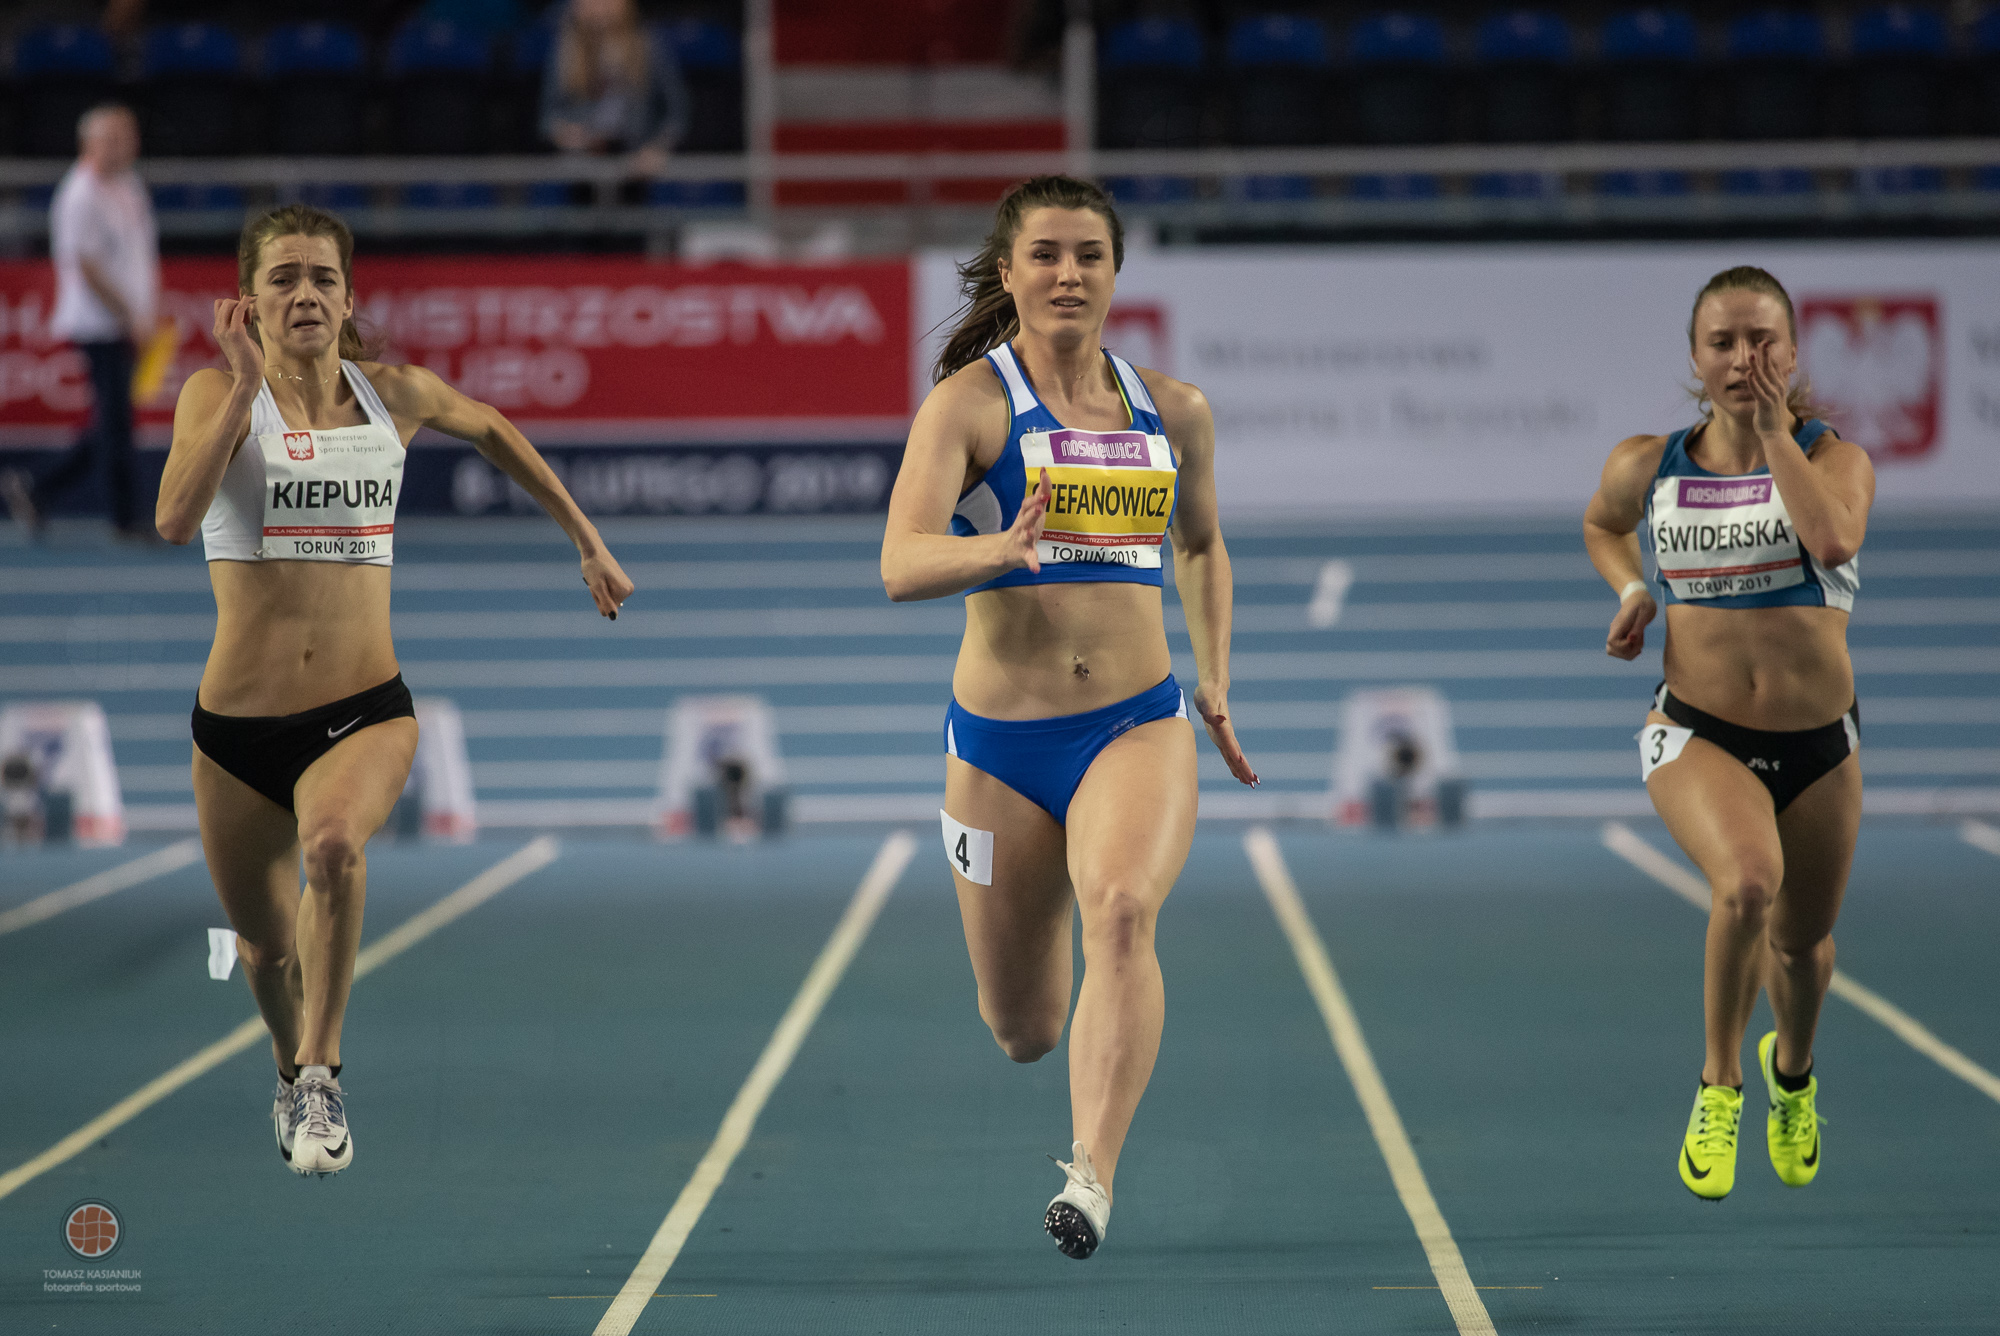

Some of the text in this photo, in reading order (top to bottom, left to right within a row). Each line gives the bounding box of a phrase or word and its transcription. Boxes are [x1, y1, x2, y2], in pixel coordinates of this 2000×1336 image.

[316, 434, 368, 442] Ministerstwo
[318, 446, 345, 455] Sportu
[352, 444, 385, 455] Turystyki
[272, 479, 393, 509] KIEPURA
[1032, 482, 1168, 518] TEFANOWICZ
[1045, 533, 1074, 541] HALOWE
[1075, 536, 1119, 544] MISTRZOSTWA
[1657, 518, 1790, 554] ŚWIDERSKA
[294, 537, 376, 554] TORUŃ 2019
[1052, 546, 1138, 564] TORUŃ 2019
[1738, 574, 1772, 591] 2019
[1650, 728, 1668, 765] 3
[955, 832, 970, 874] 4
